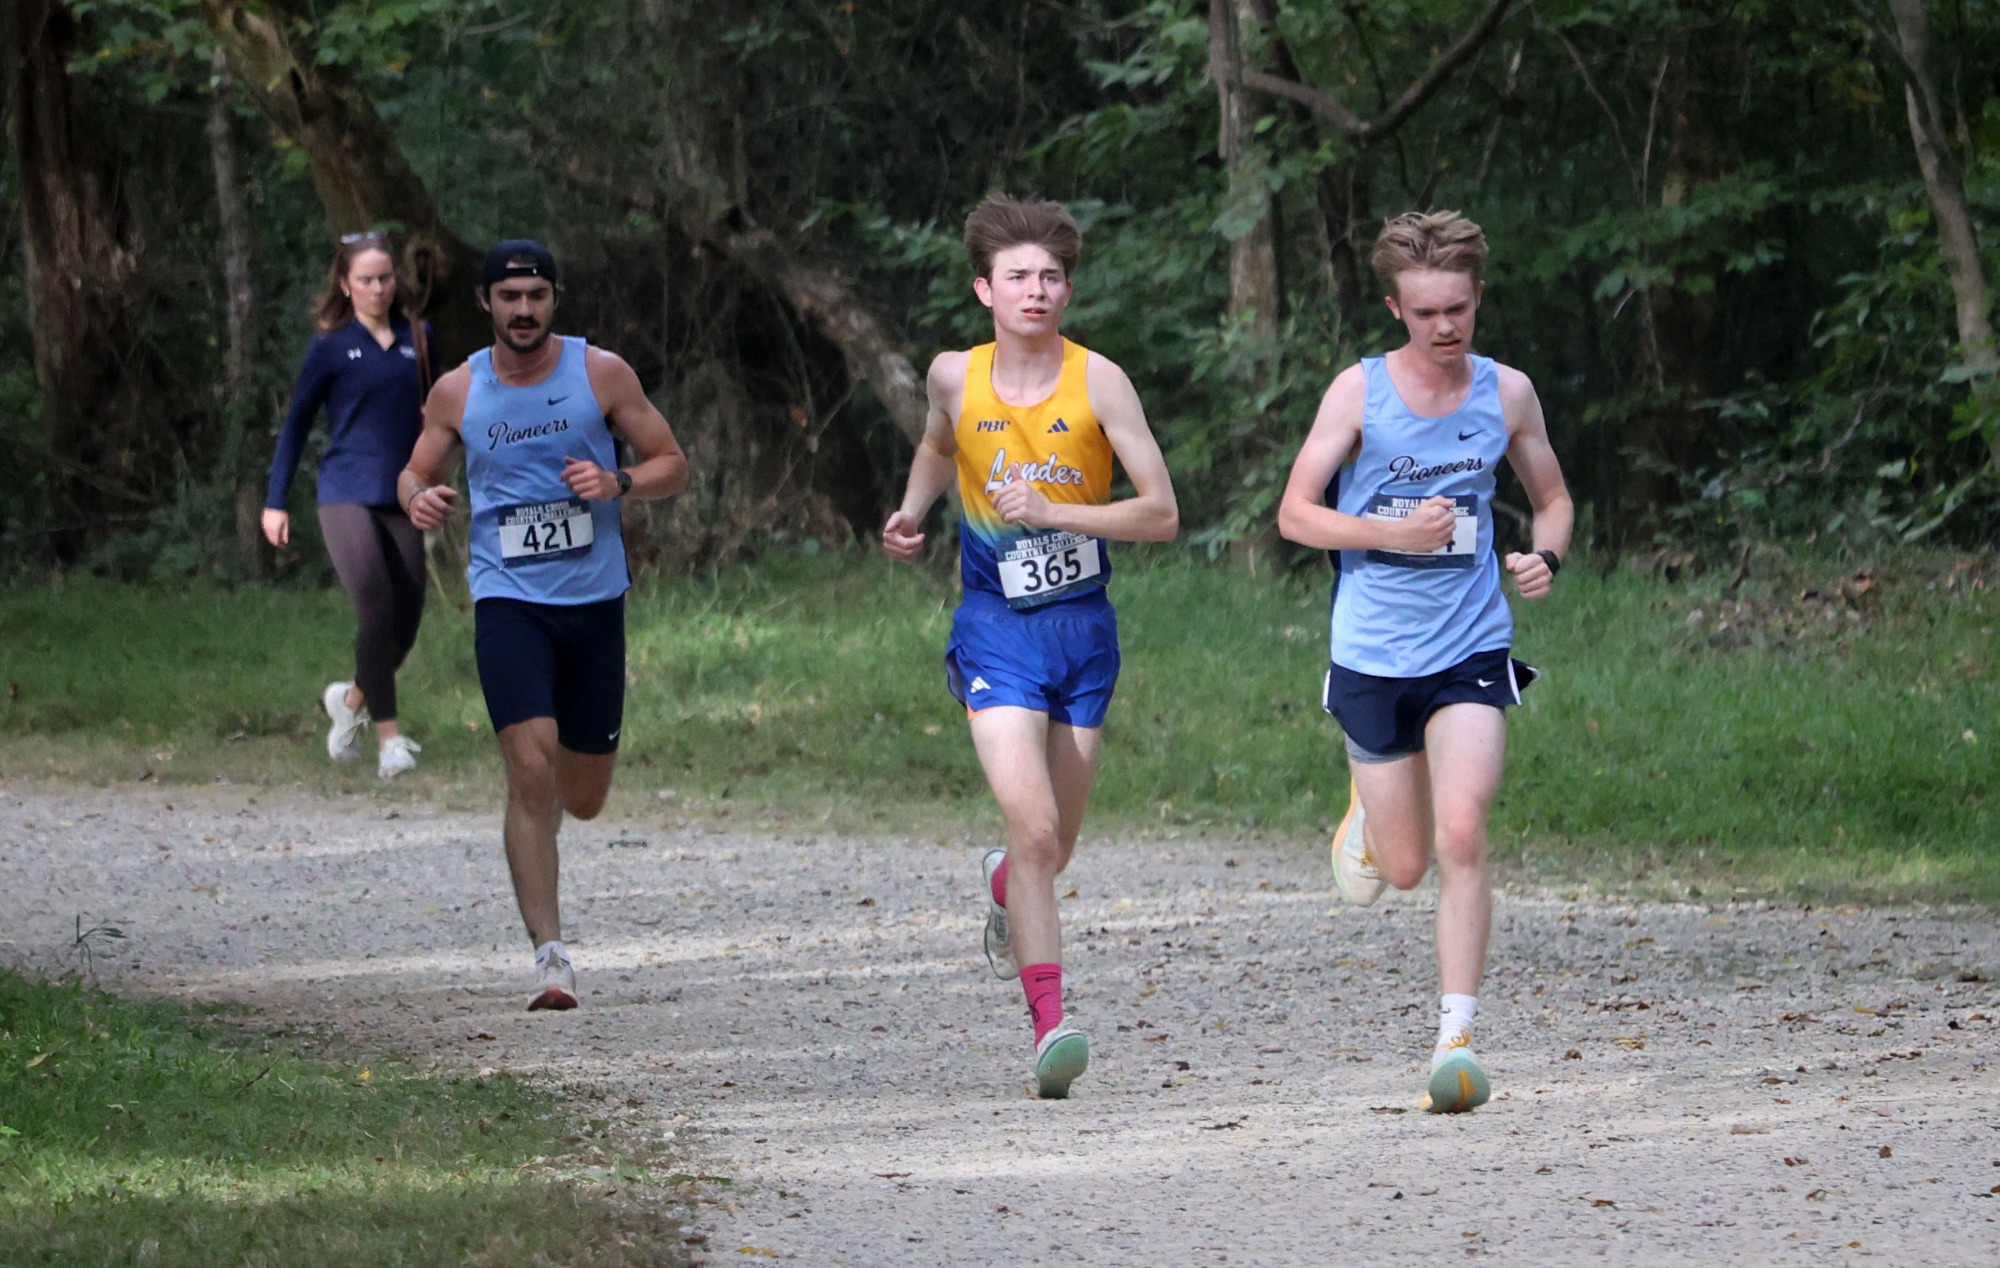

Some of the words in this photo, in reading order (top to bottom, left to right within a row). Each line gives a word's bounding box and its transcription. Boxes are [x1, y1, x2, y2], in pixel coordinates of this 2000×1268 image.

[488, 418, 569, 450] Pioneers
[1389, 455, 1485, 482] Pioneers
[523, 519, 572, 552] 421
[1015, 535, 1049, 550] ROYALS
[1005, 546, 1044, 560] COUNTRY
[1020, 549, 1081, 592] 365
